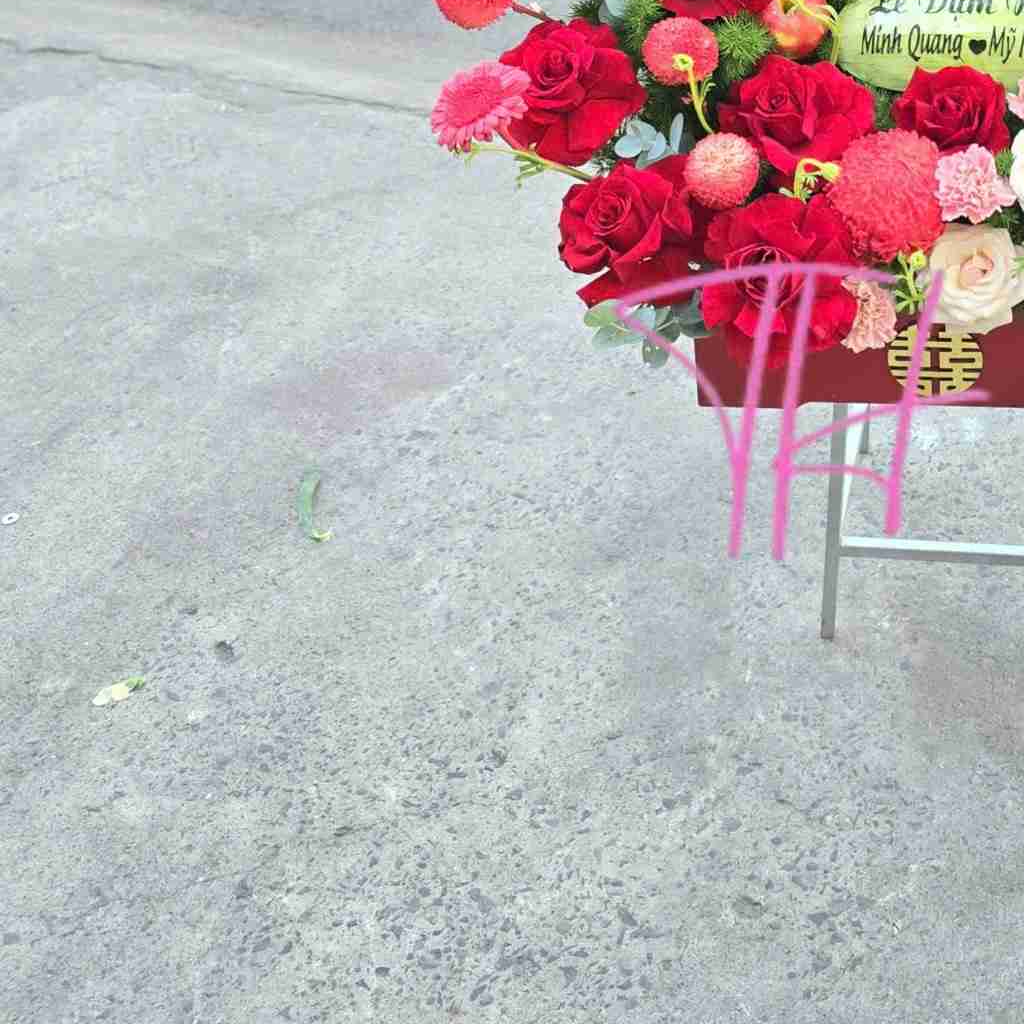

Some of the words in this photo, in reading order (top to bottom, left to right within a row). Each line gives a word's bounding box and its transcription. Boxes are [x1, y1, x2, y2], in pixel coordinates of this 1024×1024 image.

[860, 25, 902, 55] Minh
[908, 23, 964, 62] Quang
[988, 25, 1017, 64] Mỹ
